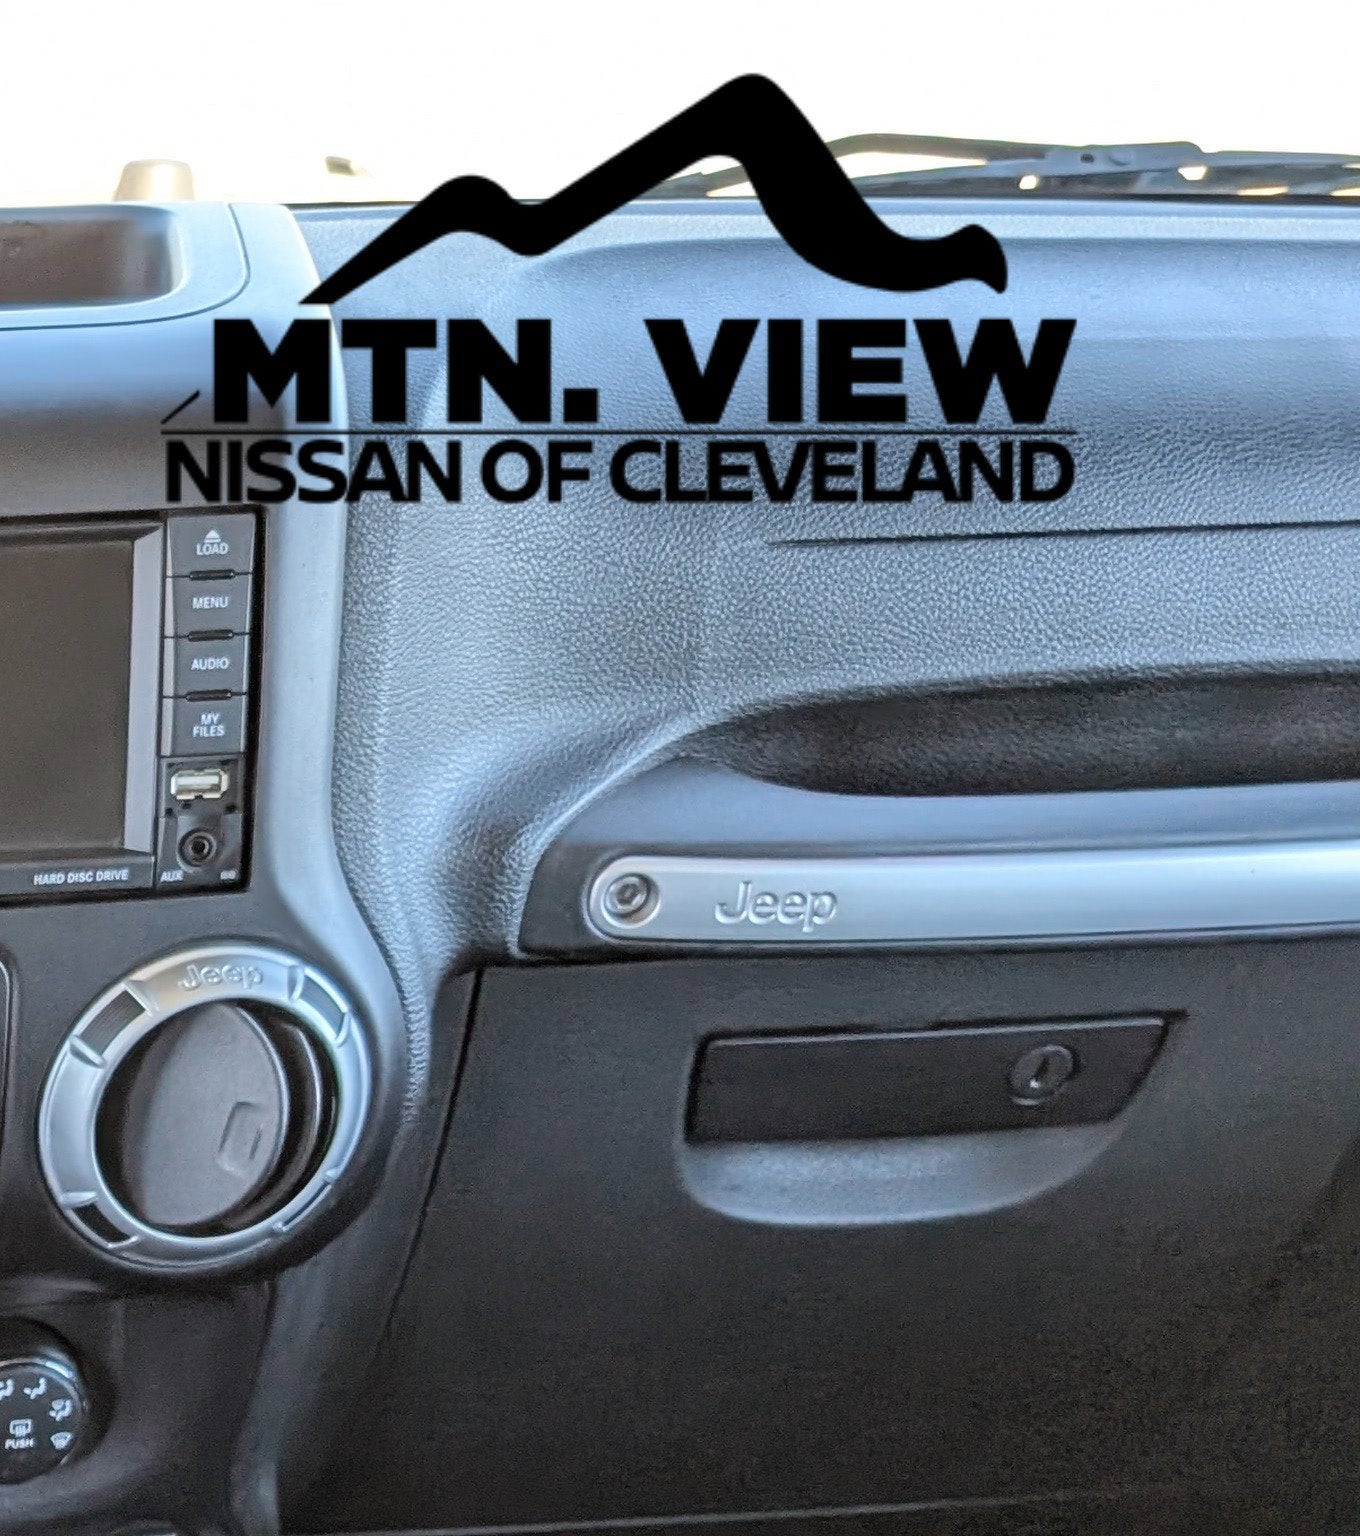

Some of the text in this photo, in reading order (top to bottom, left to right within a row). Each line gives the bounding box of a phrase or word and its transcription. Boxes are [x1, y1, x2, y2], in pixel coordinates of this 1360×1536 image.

[196, 542, 229, 556] LOAD
[193, 596, 229, 610] MENU
[191, 657, 231, 671] AUDIO
[201, 713, 221, 726] MY
[193, 724, 226, 738] FILES
[33, 868, 129, 886] HARD DISC DRIVE
[714, 880, 838, 933] Jeep
[178, 964, 263, 990] Jeep
[5, 1438, 34, 1450] PUSH
